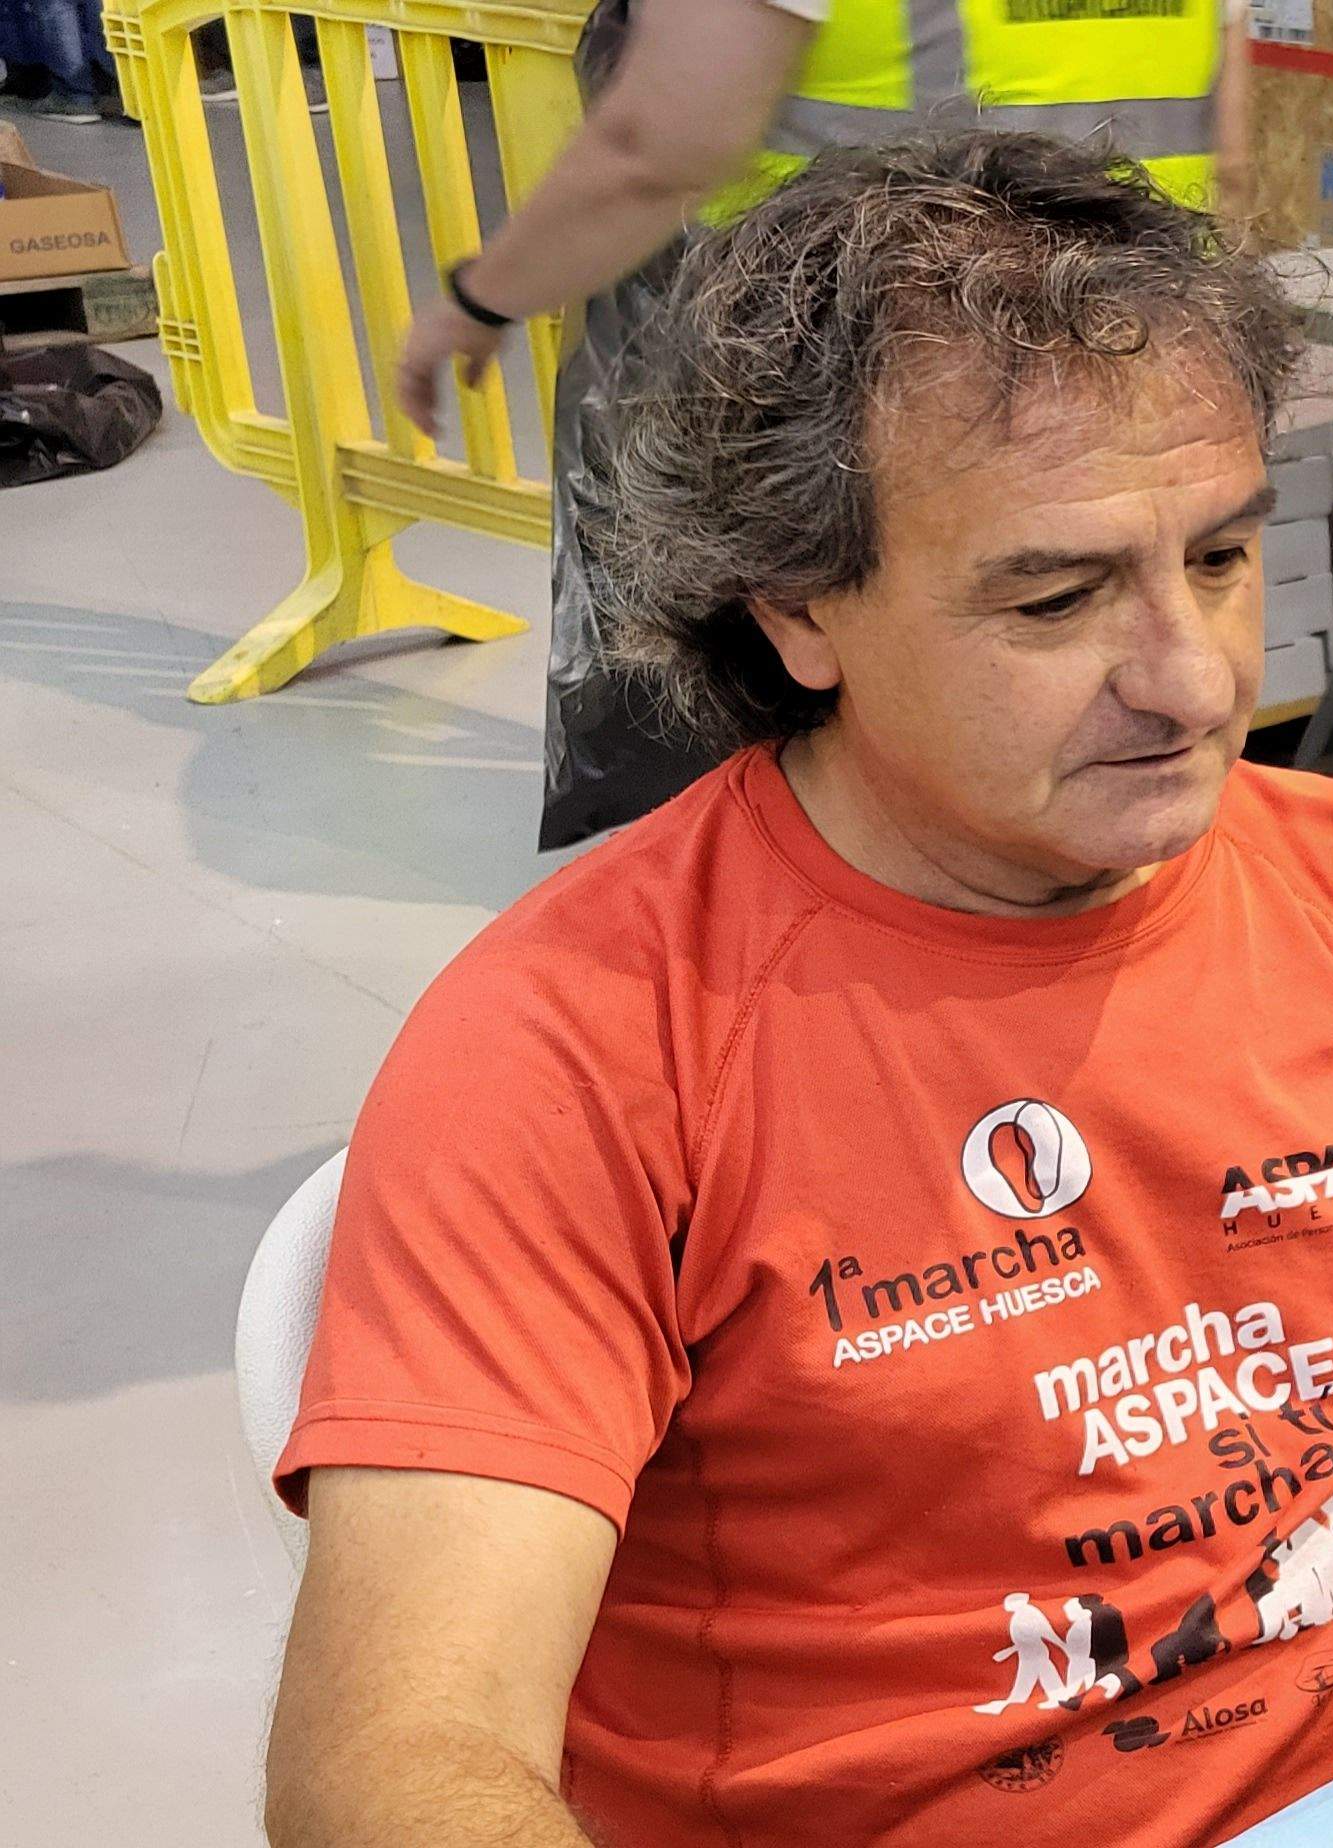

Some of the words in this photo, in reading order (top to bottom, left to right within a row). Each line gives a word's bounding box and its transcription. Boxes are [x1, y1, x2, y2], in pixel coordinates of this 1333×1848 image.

[10, 231, 109, 253] GASEOSA
[861, 1226, 1086, 1318] marcha
[1226, 1234, 1284, 1253] Asociación
[832, 1304, 974, 1369] ASPACE
[978, 1266, 1101, 1325] HUESCA
[1034, 1301, 1285, 1421] marcha
[1208, 1412, 1271, 1470] si
[1181, 1695, 1269, 1738] Alosa
